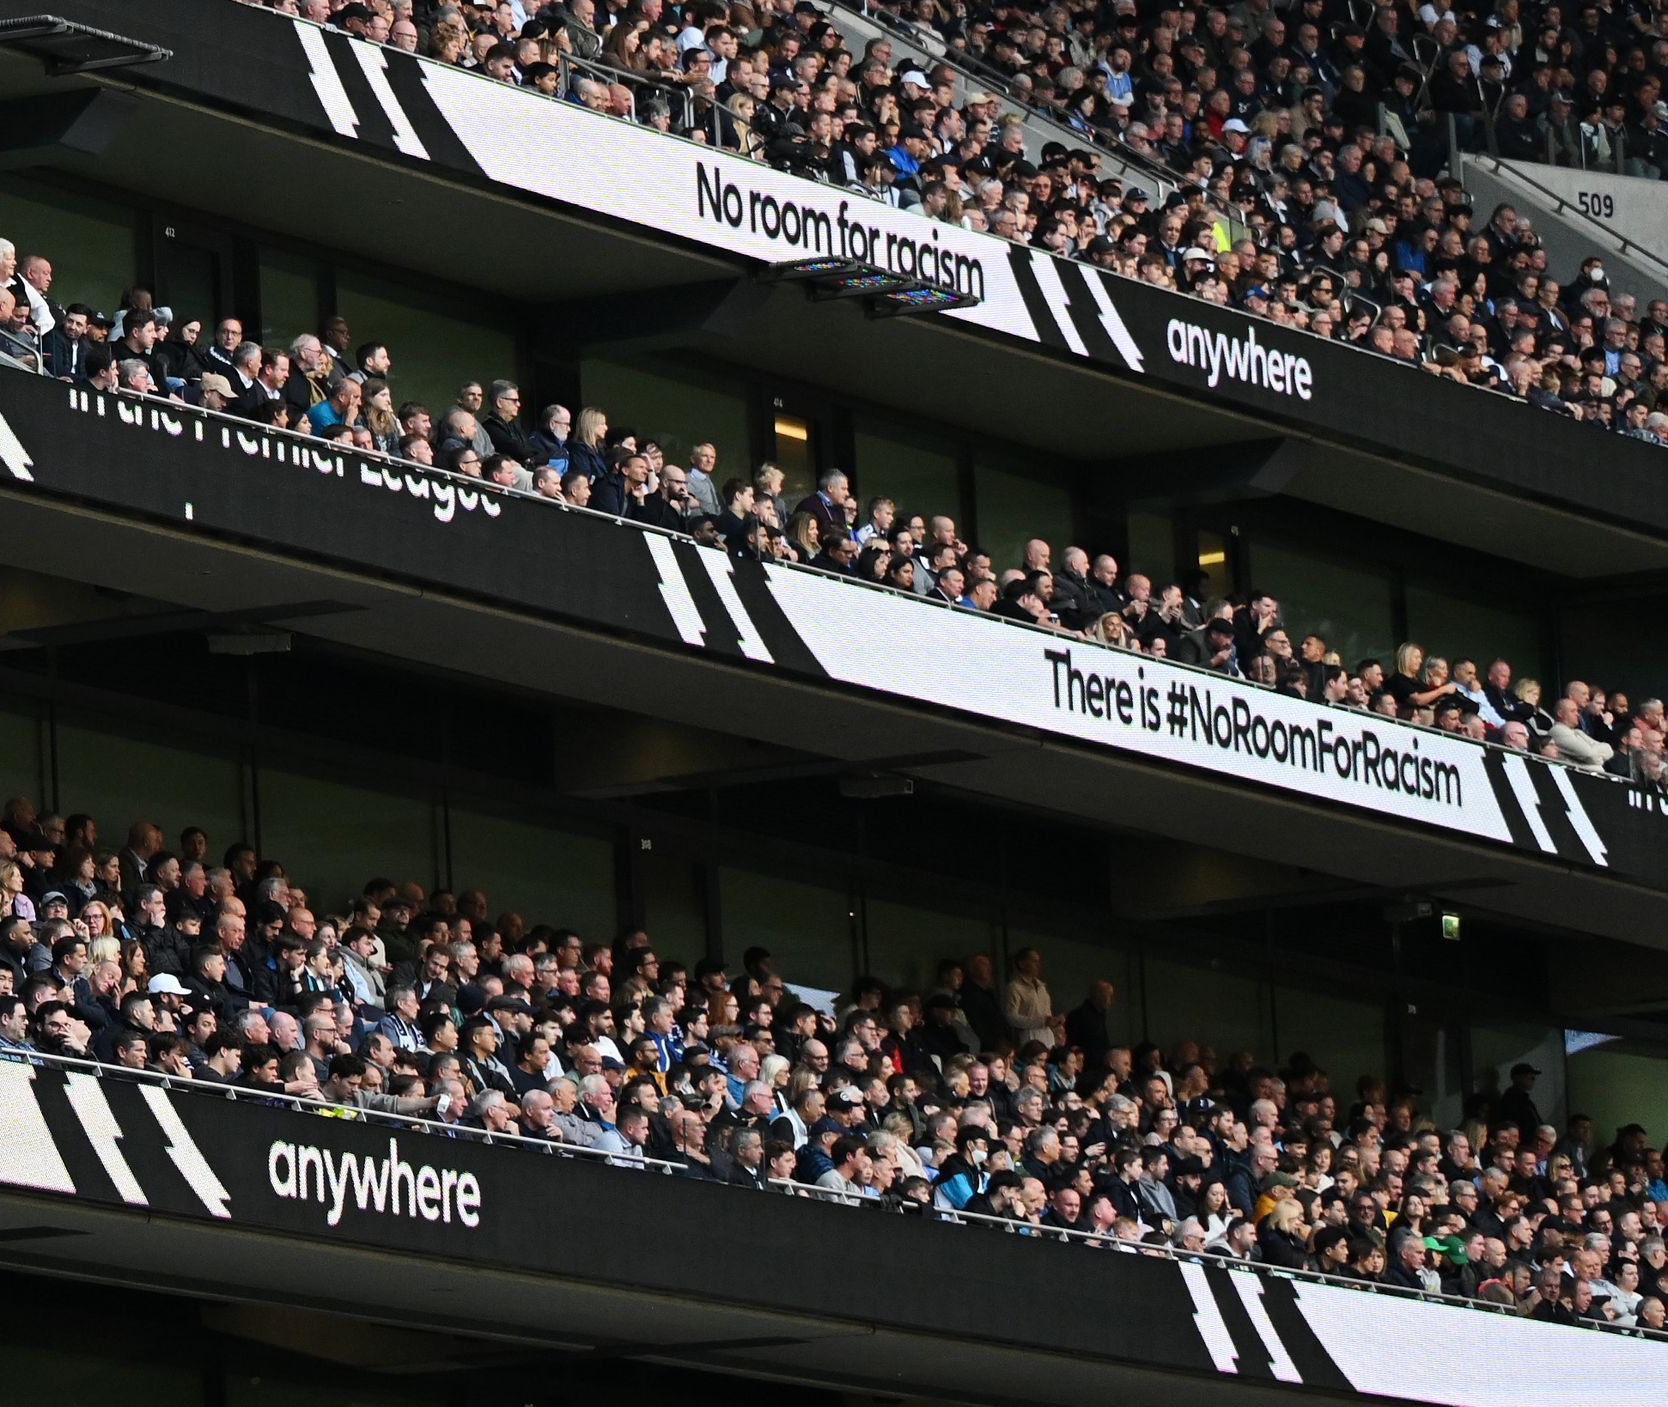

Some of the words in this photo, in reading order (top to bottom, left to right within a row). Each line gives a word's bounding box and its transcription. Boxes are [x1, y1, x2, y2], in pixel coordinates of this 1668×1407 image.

[164, 226, 176, 238] 412
[697, 162, 743, 227] No
[750, 190, 833, 256] room
[838, 200, 880, 264] for
[886, 229, 984, 301] racism
[1578, 191, 1615, 218] 509
[1167, 315, 1313, 401] anywhere
[1044, 649, 1134, 724] There
[1141, 667, 1161, 731] is
[1167, 681, 1463, 809] #NoRoomForRacism
[268, 1137, 481, 1227] anywhere
